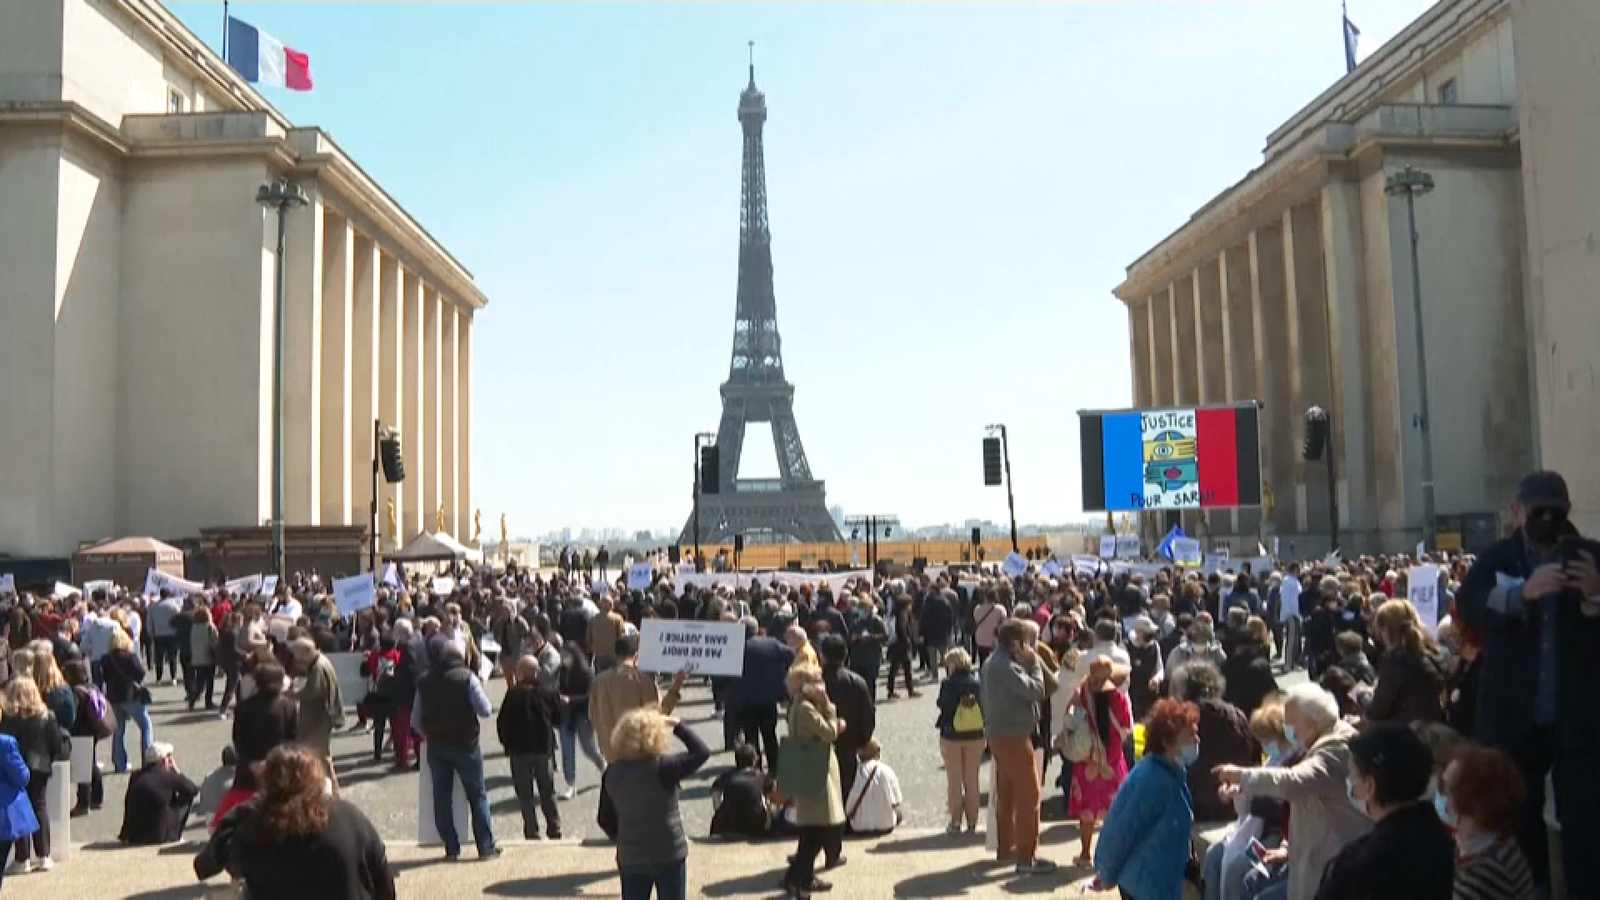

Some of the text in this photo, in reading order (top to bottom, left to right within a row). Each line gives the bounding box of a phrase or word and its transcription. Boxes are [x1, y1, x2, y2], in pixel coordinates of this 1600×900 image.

[1131, 493, 1161, 507] POUR
[665, 632, 702, 644] JUSTICE
[704, 634, 728, 646] SANS
[661, 645, 722, 659] PAS DE DROIT
